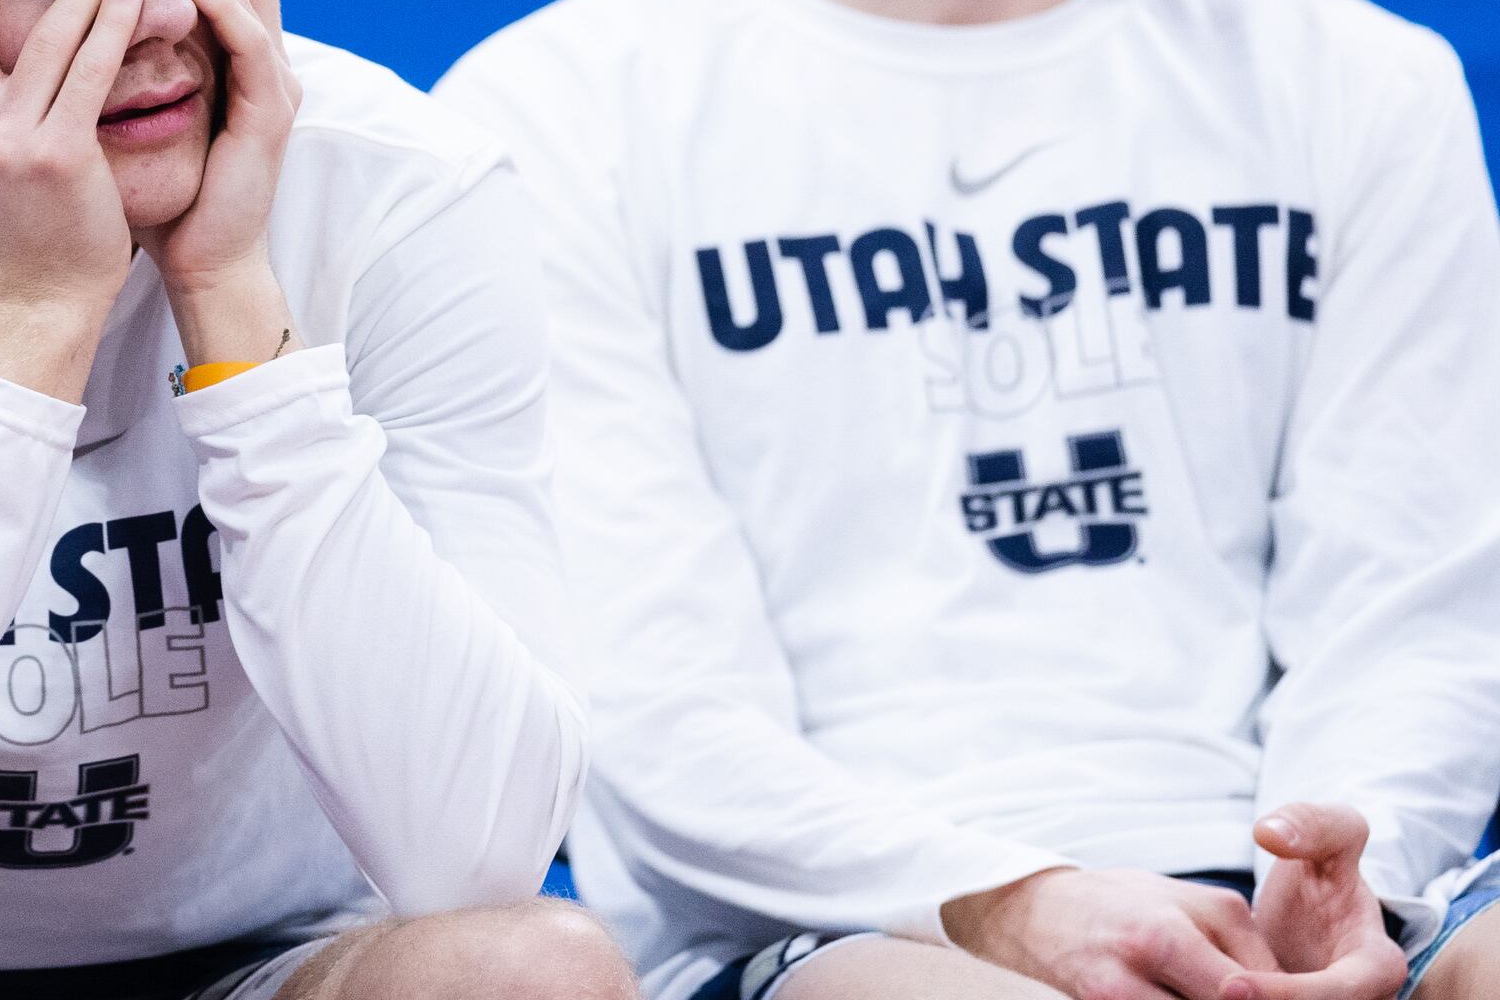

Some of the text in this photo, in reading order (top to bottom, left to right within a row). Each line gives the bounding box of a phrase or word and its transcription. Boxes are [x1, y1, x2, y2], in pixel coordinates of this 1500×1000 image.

[695, 200, 1318, 353] UTAH STATE
[959, 470, 1150, 533] STATE
